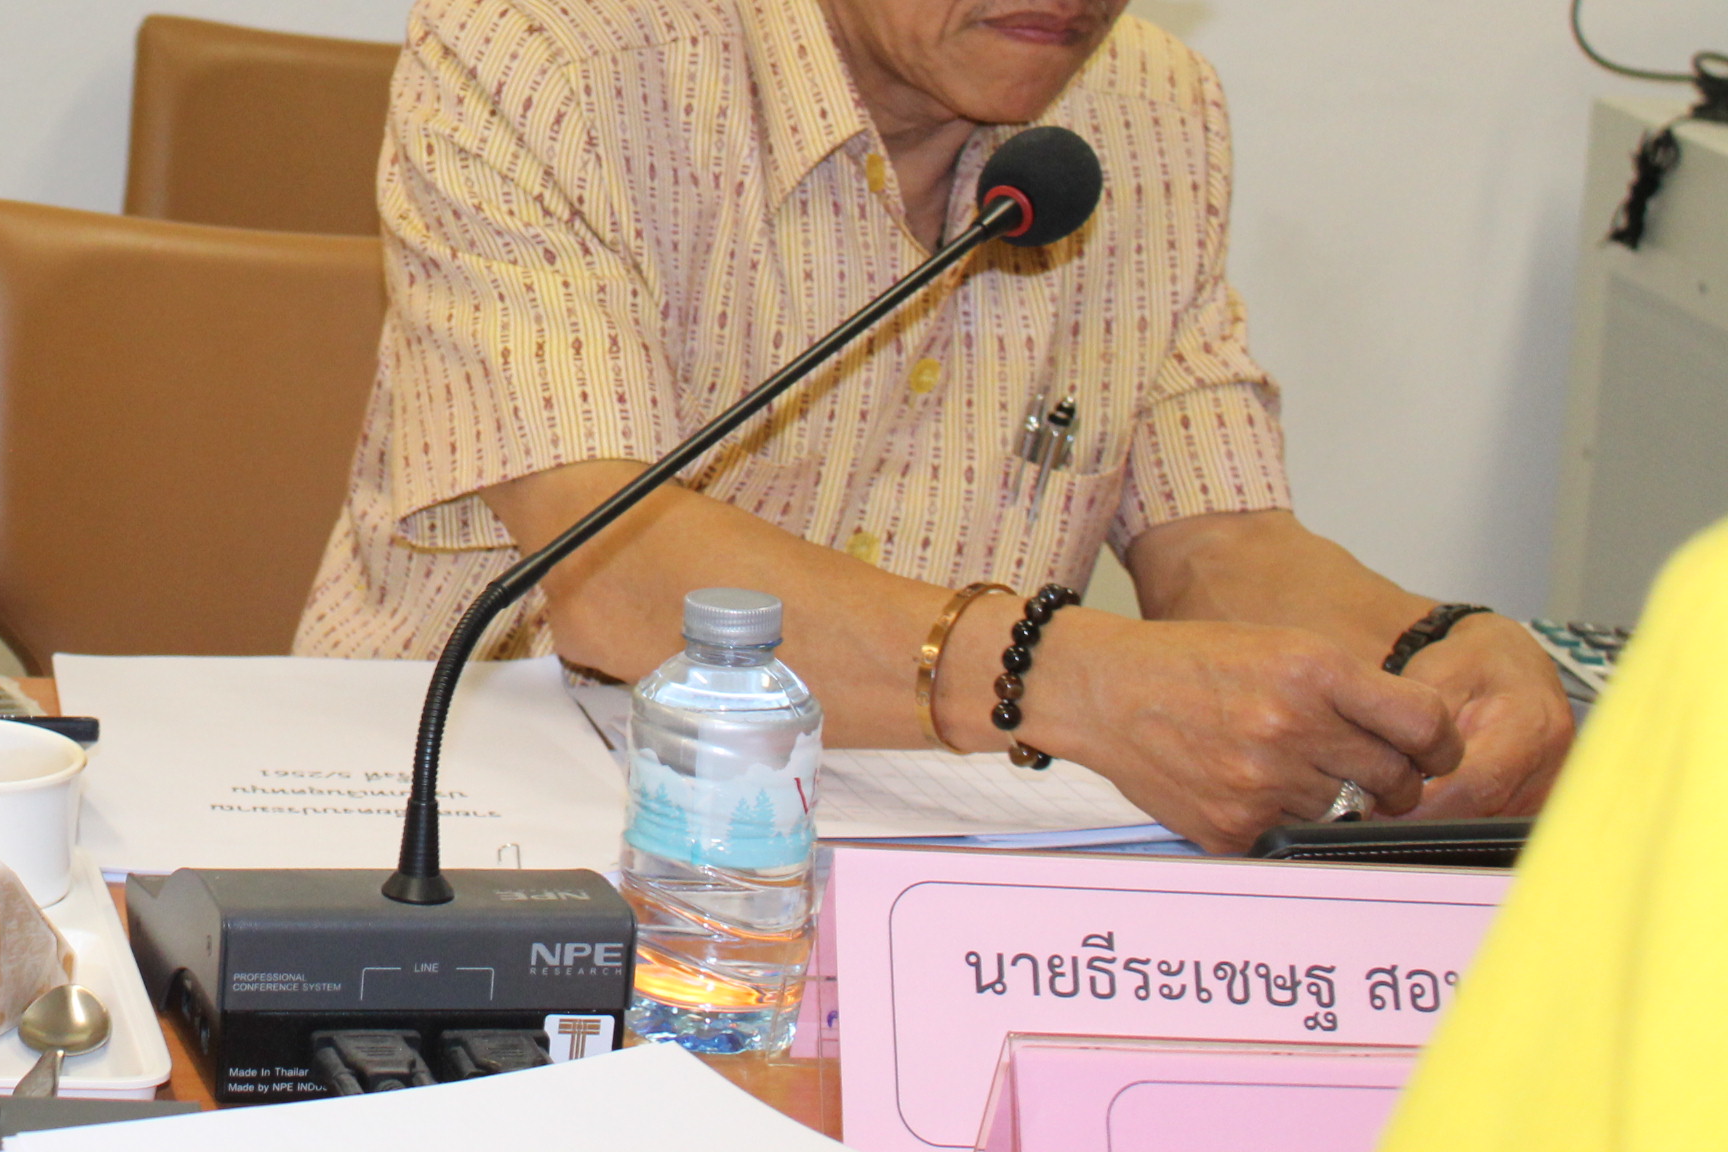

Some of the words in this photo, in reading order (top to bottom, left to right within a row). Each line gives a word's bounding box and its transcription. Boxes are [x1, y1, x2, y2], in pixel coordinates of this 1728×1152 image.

[260, 768, 351, 780] 5/2561
[530, 942, 624, 967] NPE
[414, 963, 440, 973] LINE
[529, 967, 622, 976] RESEARCH
[233, 973, 307, 982] PROFESSIONAL
[964, 930, 1339, 1032] นายธีระเชษฐ
[232, 982, 300, 992] CONFERENCE
[302, 982, 342, 992] SYSTEM
[229, 1067, 258, 1078] Made
[261, 1067, 271, 1078] In
[275, 1066, 310, 1078] Thaila
[228, 1082, 255, 1092] Made
[257, 1082, 270, 1094] by
[272, 1082, 294, 1092] NPE
